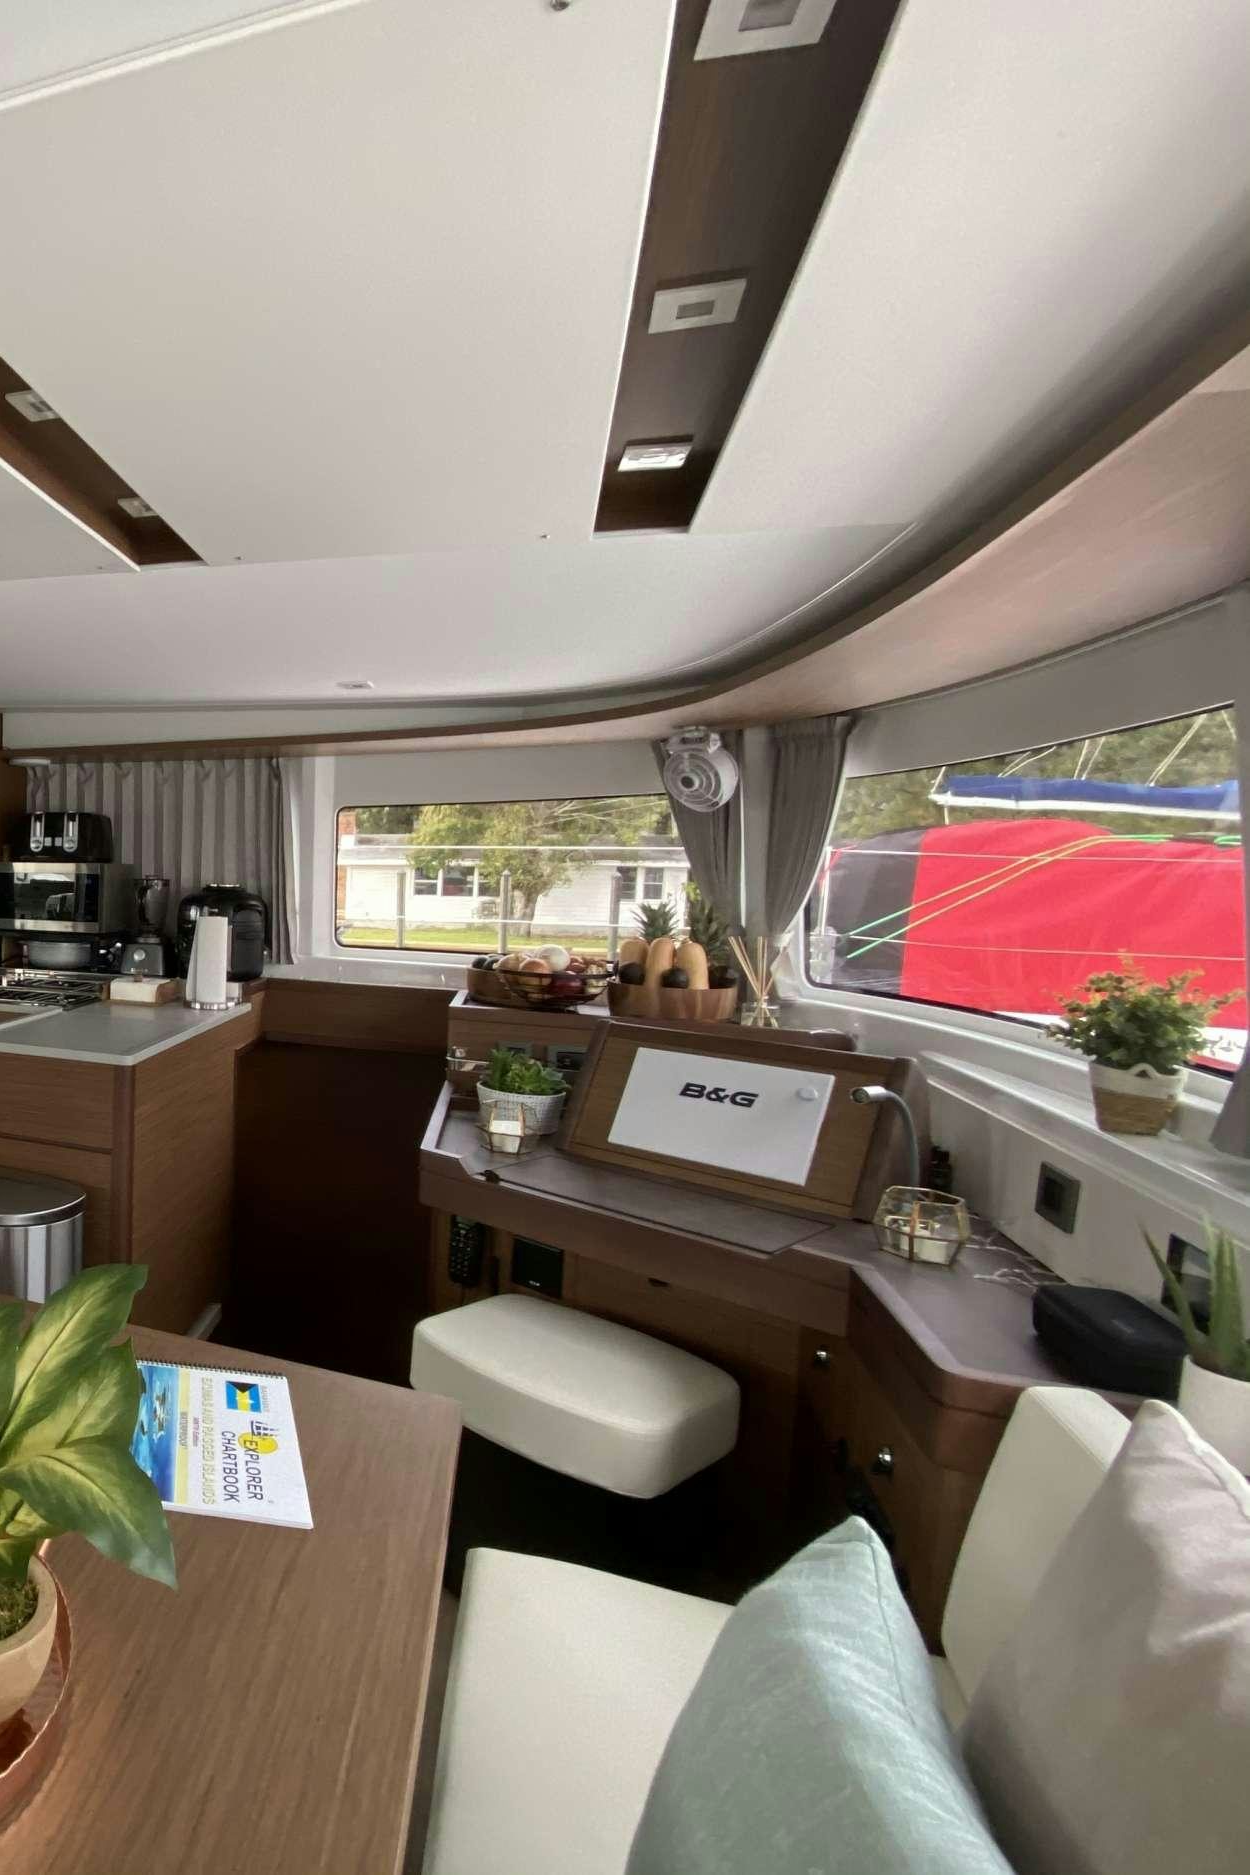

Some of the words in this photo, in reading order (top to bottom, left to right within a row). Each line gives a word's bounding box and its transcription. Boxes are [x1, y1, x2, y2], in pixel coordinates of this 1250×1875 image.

[679, 1082, 759, 1108] B&G
[202, 1463, 215, 1504] ISLANDS
[222, 1430, 240, 1503] CHARTBOOK
[244, 1439, 264, 1501] EXPLORER
